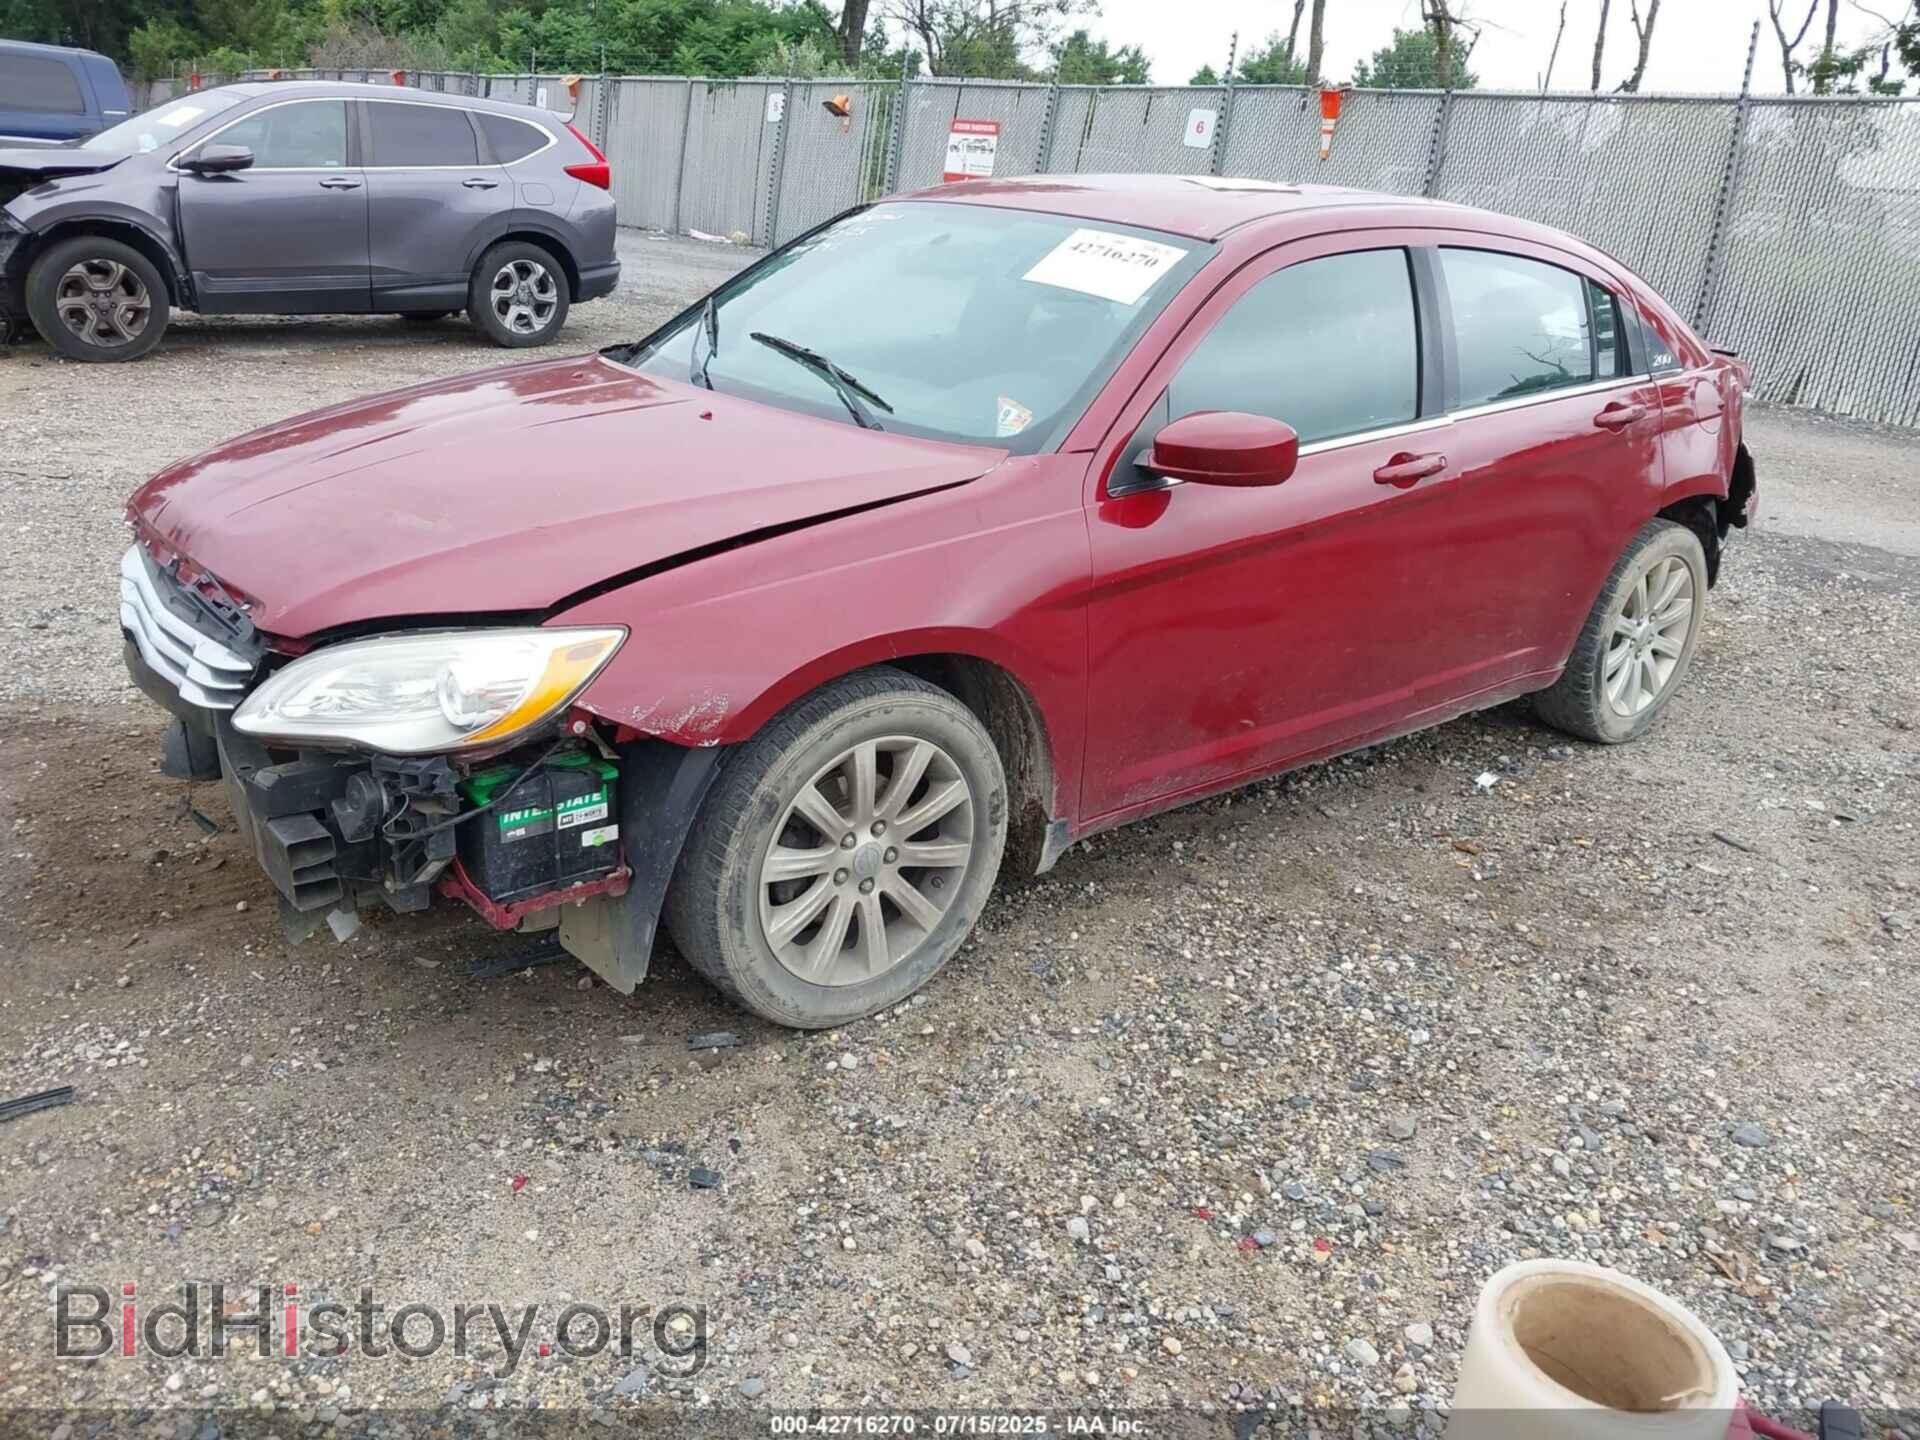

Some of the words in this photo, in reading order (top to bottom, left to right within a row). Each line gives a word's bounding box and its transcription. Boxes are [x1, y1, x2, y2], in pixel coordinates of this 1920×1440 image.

[1195, 120, 1205, 134] 6
[1070, 242, 1159, 267] 42716270
[503, 792, 603, 824] INTESTATE
